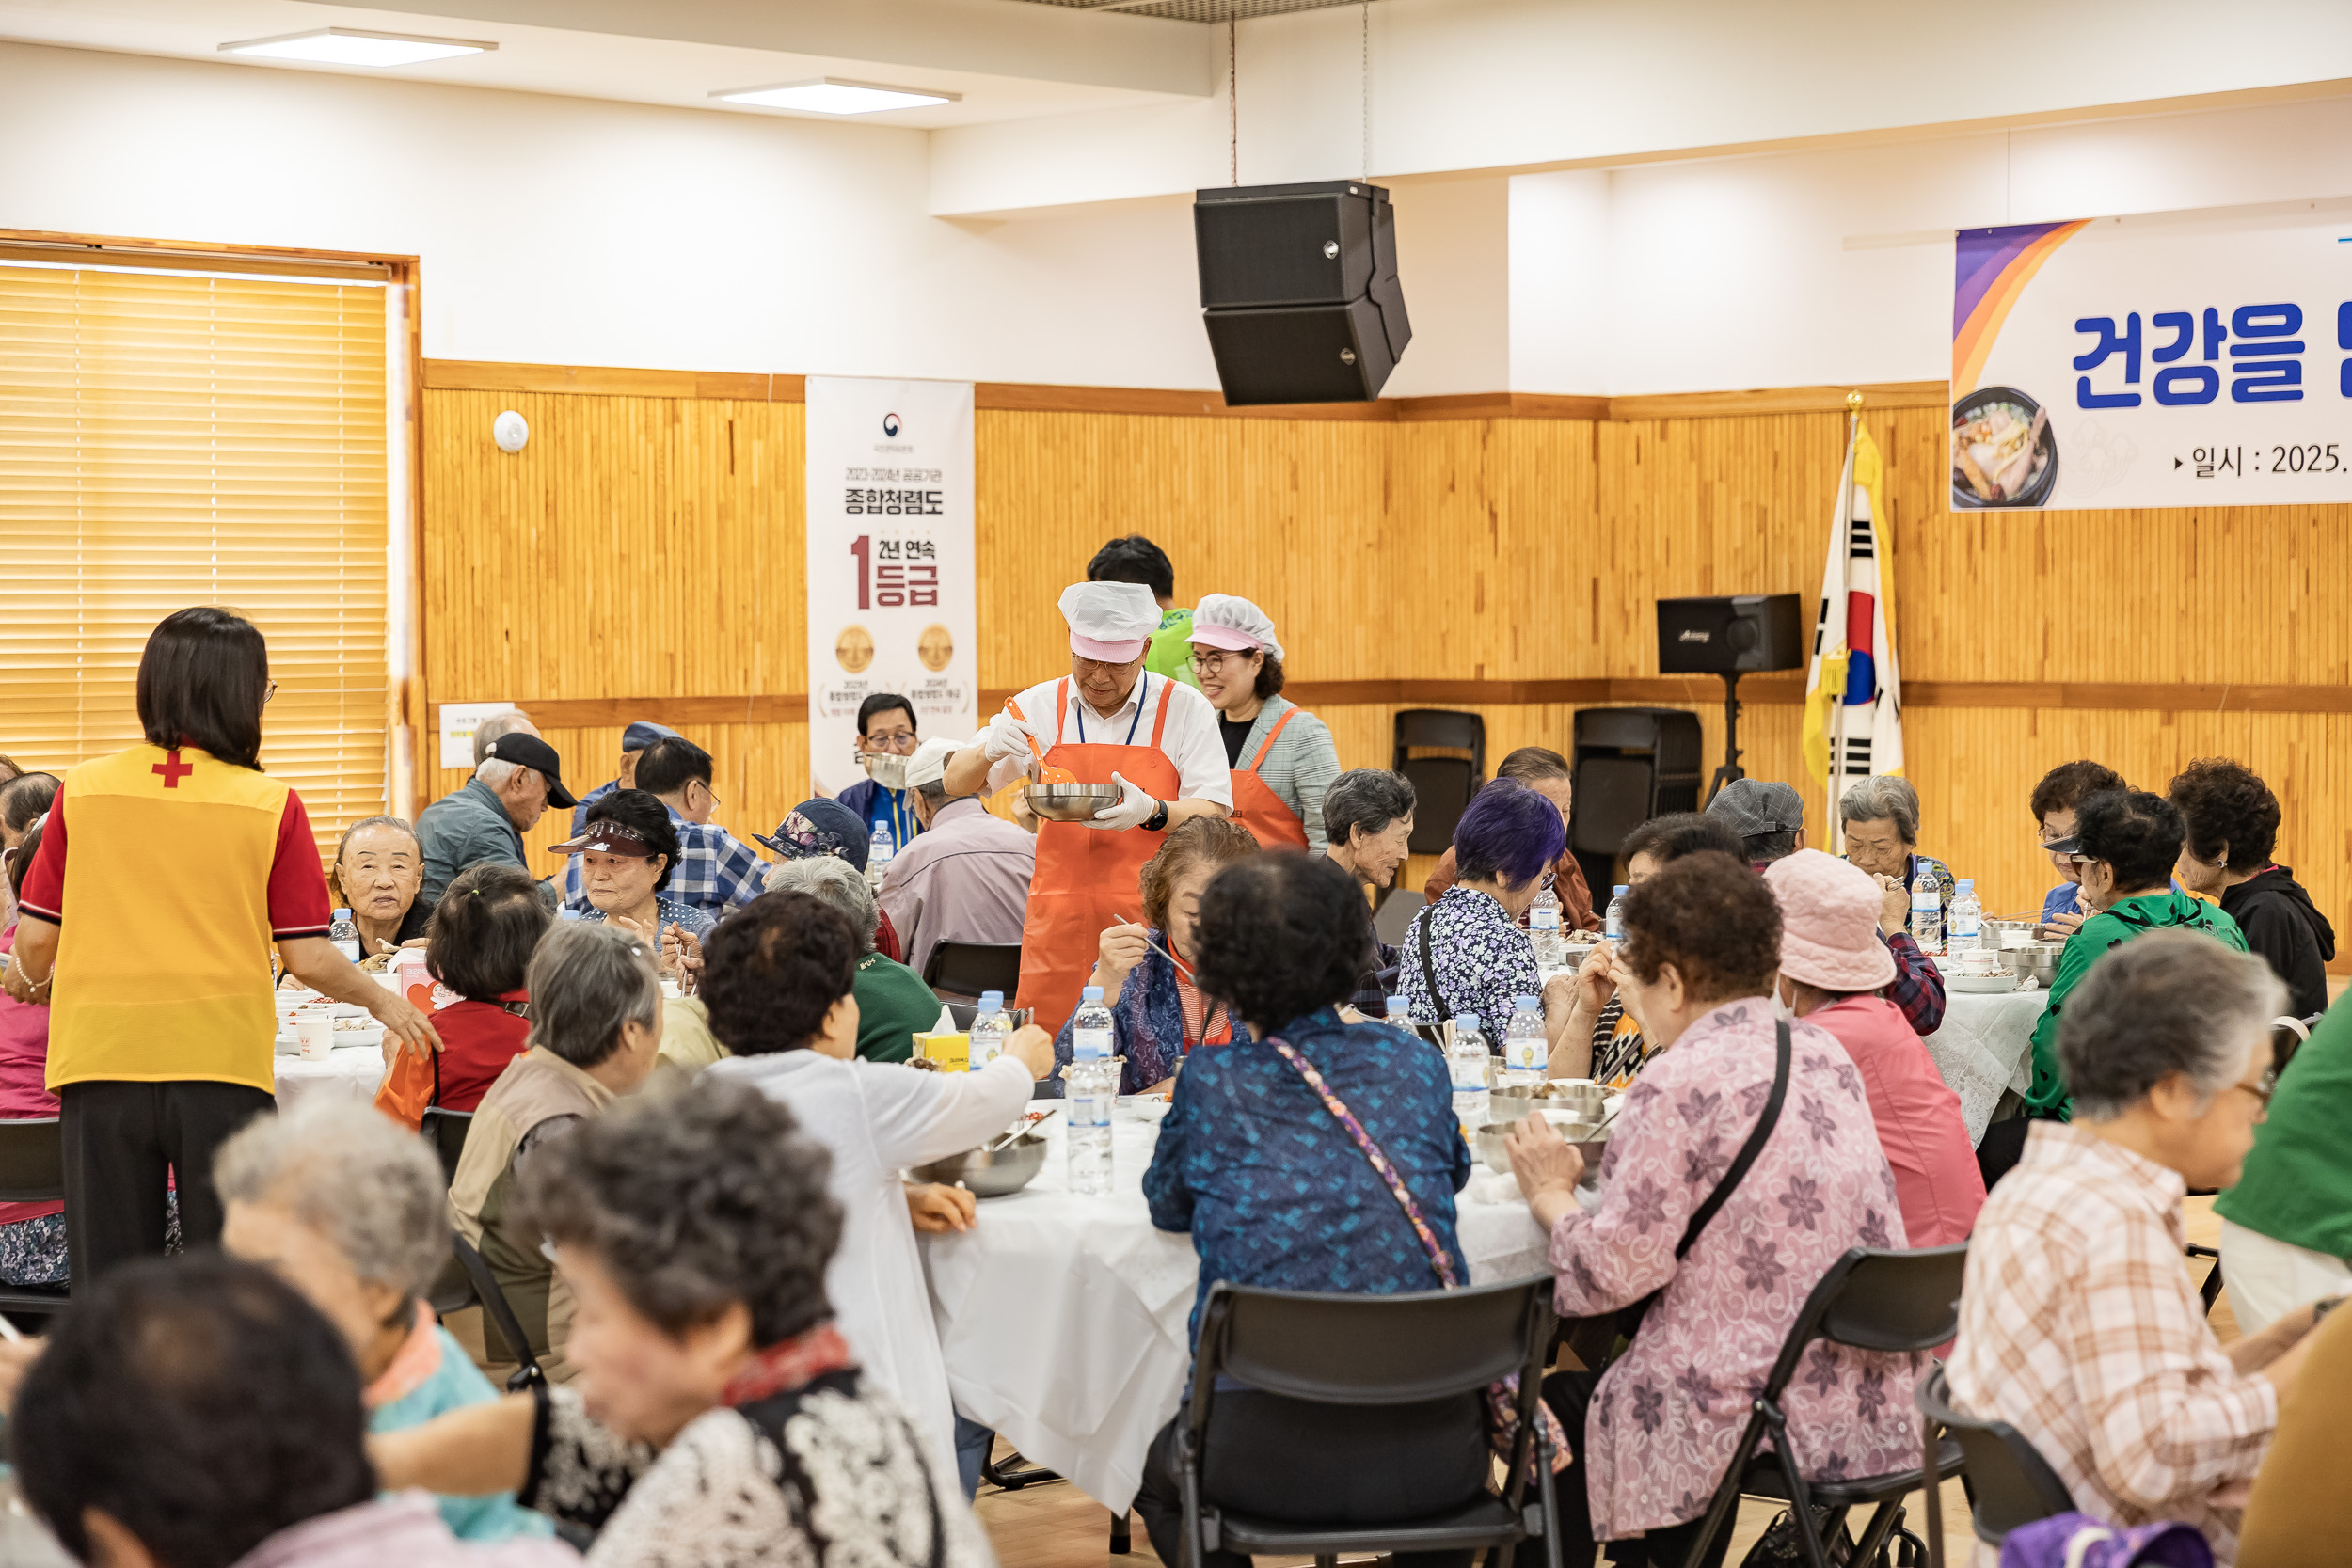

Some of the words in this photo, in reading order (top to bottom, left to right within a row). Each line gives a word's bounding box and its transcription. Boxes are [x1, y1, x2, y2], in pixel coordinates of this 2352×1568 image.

[2073, 302, 2306, 410] 건강을
[2192, 445, 2242, 479] 일시
[2271, 444, 2348, 473] 2025.
[845, 488, 944, 515] 종합청렴도
[879, 540, 900, 560] 2년
[905, 539, 935, 560] 연속
[850, 534, 870, 610] 1
[876, 565, 939, 607] 등급
